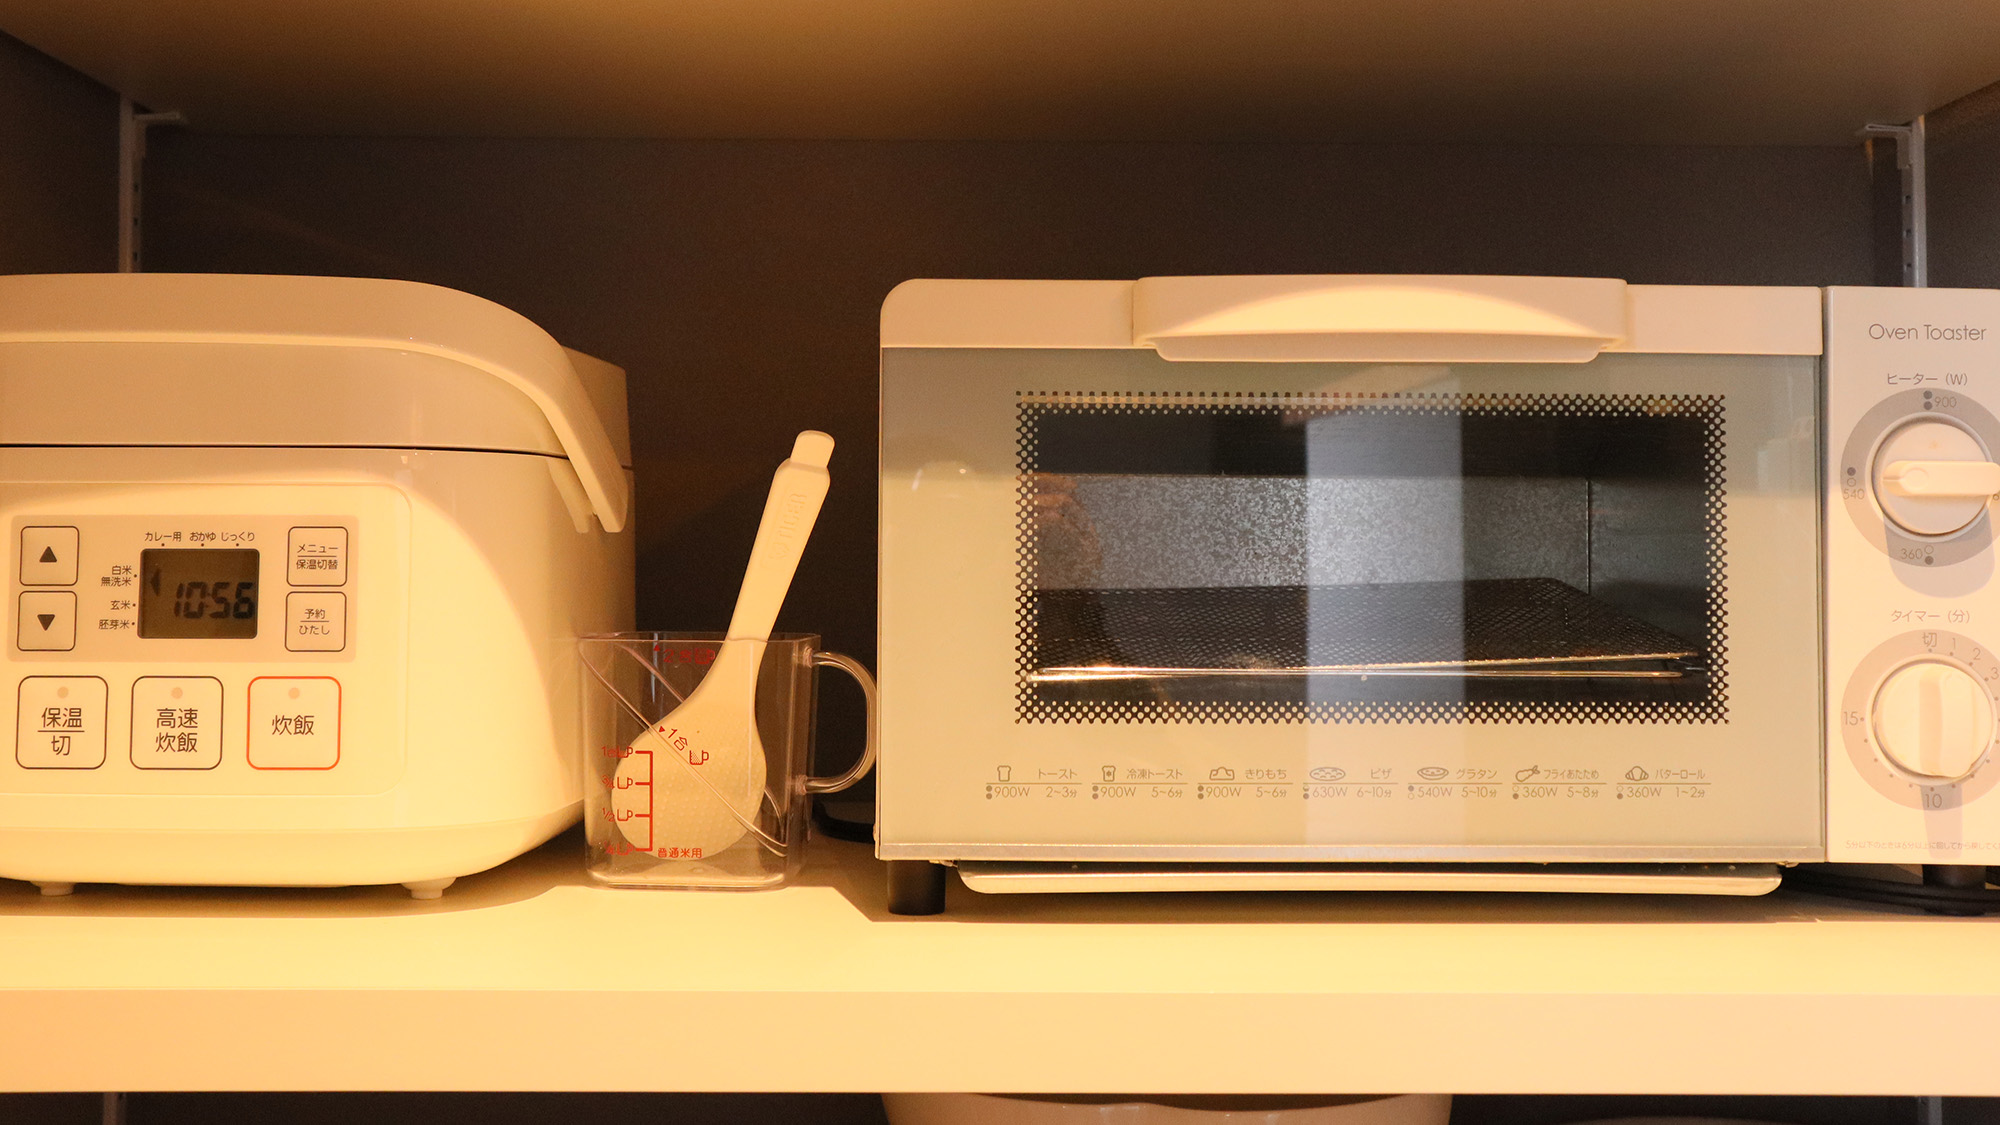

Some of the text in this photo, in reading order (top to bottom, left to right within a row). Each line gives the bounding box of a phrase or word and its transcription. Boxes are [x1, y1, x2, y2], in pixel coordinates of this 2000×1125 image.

[1868, 323, 1987, 341] Oven Toaster
[1934, 397, 1957, 408] 900
[1843, 488, 1865, 500] 540
[144, 531, 182, 542] カレー用
[189, 531, 217, 542] おかゆ
[220, 531, 256, 542] じっくり
[297, 543, 339, 554] メニュー
[1901, 549, 1923, 559] 360
[111, 565, 132, 575] 白米
[296, 559, 338, 570] 保温切替
[101, 576, 131, 587] 無洗米
[110, 600, 131, 610] 玄米
[173, 581, 256, 620] 10:56
[304, 608, 326, 619] 予約
[98, 619, 130, 630] 胚芽米
[298, 624, 330, 636] ひたし
[1922, 632, 1938, 648] 切
[1972, 647, 1982, 661] 2
[1990, 666, 2000, 680] 3
[41, 707, 83, 729] 保温
[156, 708, 199, 730] 高速
[1843, 712, 1860, 726] 15
[271, 715, 315, 737] 炊飯
[51, 735, 71, 756] 切
[155, 732, 198, 754] 炊飯
[1037, 768, 1078, 780] トースト
[1126, 767, 1184, 780] 冷凍トースト
[1244, 768, 1287, 780] きりもち
[1455, 768, 1498, 780] グラタン
[1543, 769, 1600, 780] フライあたため
[994, 786, 1031, 798] 900W
[1100, 786, 1136, 798] 900W
[1205, 786, 1242, 798] 900W
[1312, 786, 1348, 798] 630W
[1417, 786, 1454, 798] 540W
[1522, 786, 1558, 798] 360W
[1626, 786, 1662, 798] 360W
[1925, 794, 1942, 809] 10
